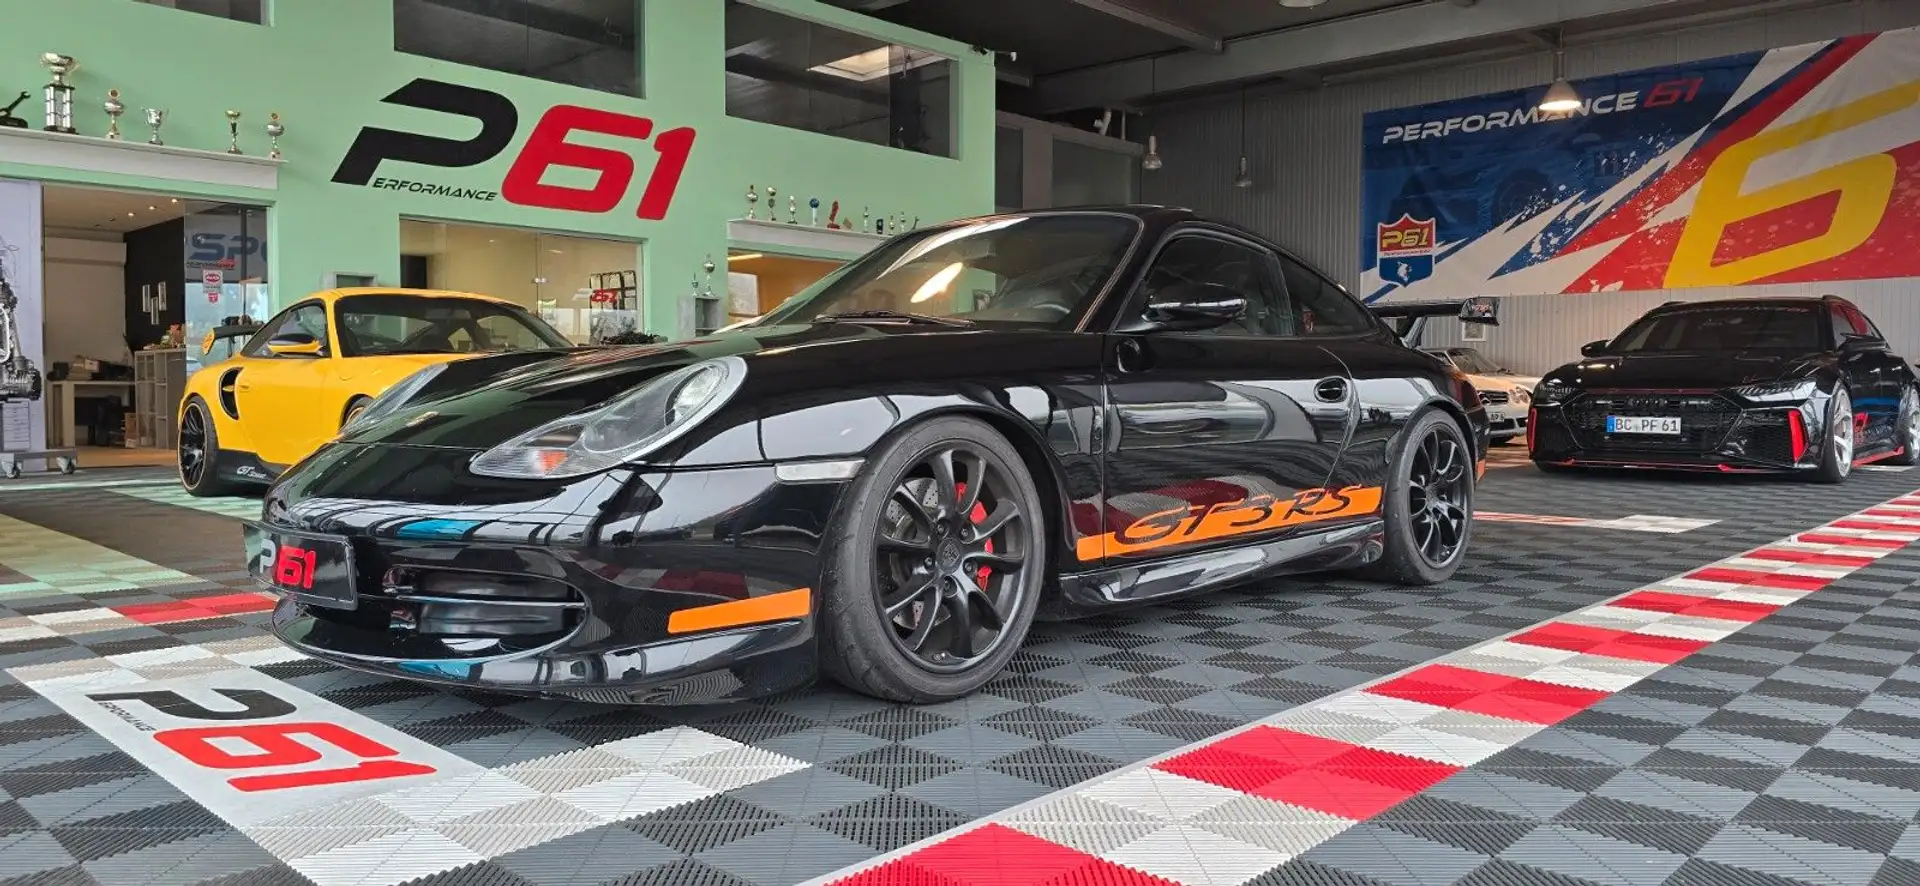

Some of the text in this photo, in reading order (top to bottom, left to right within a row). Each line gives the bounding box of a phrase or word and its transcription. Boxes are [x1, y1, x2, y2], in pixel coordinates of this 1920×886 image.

[1643, 77, 1704, 108] 61
[330, 78, 696, 221] P61
[1381, 227, 1430, 249] P61
[1615, 418, 1678, 432] BC PF 61
[259, 538, 316, 590] P61
[85, 689, 438, 793] P61
